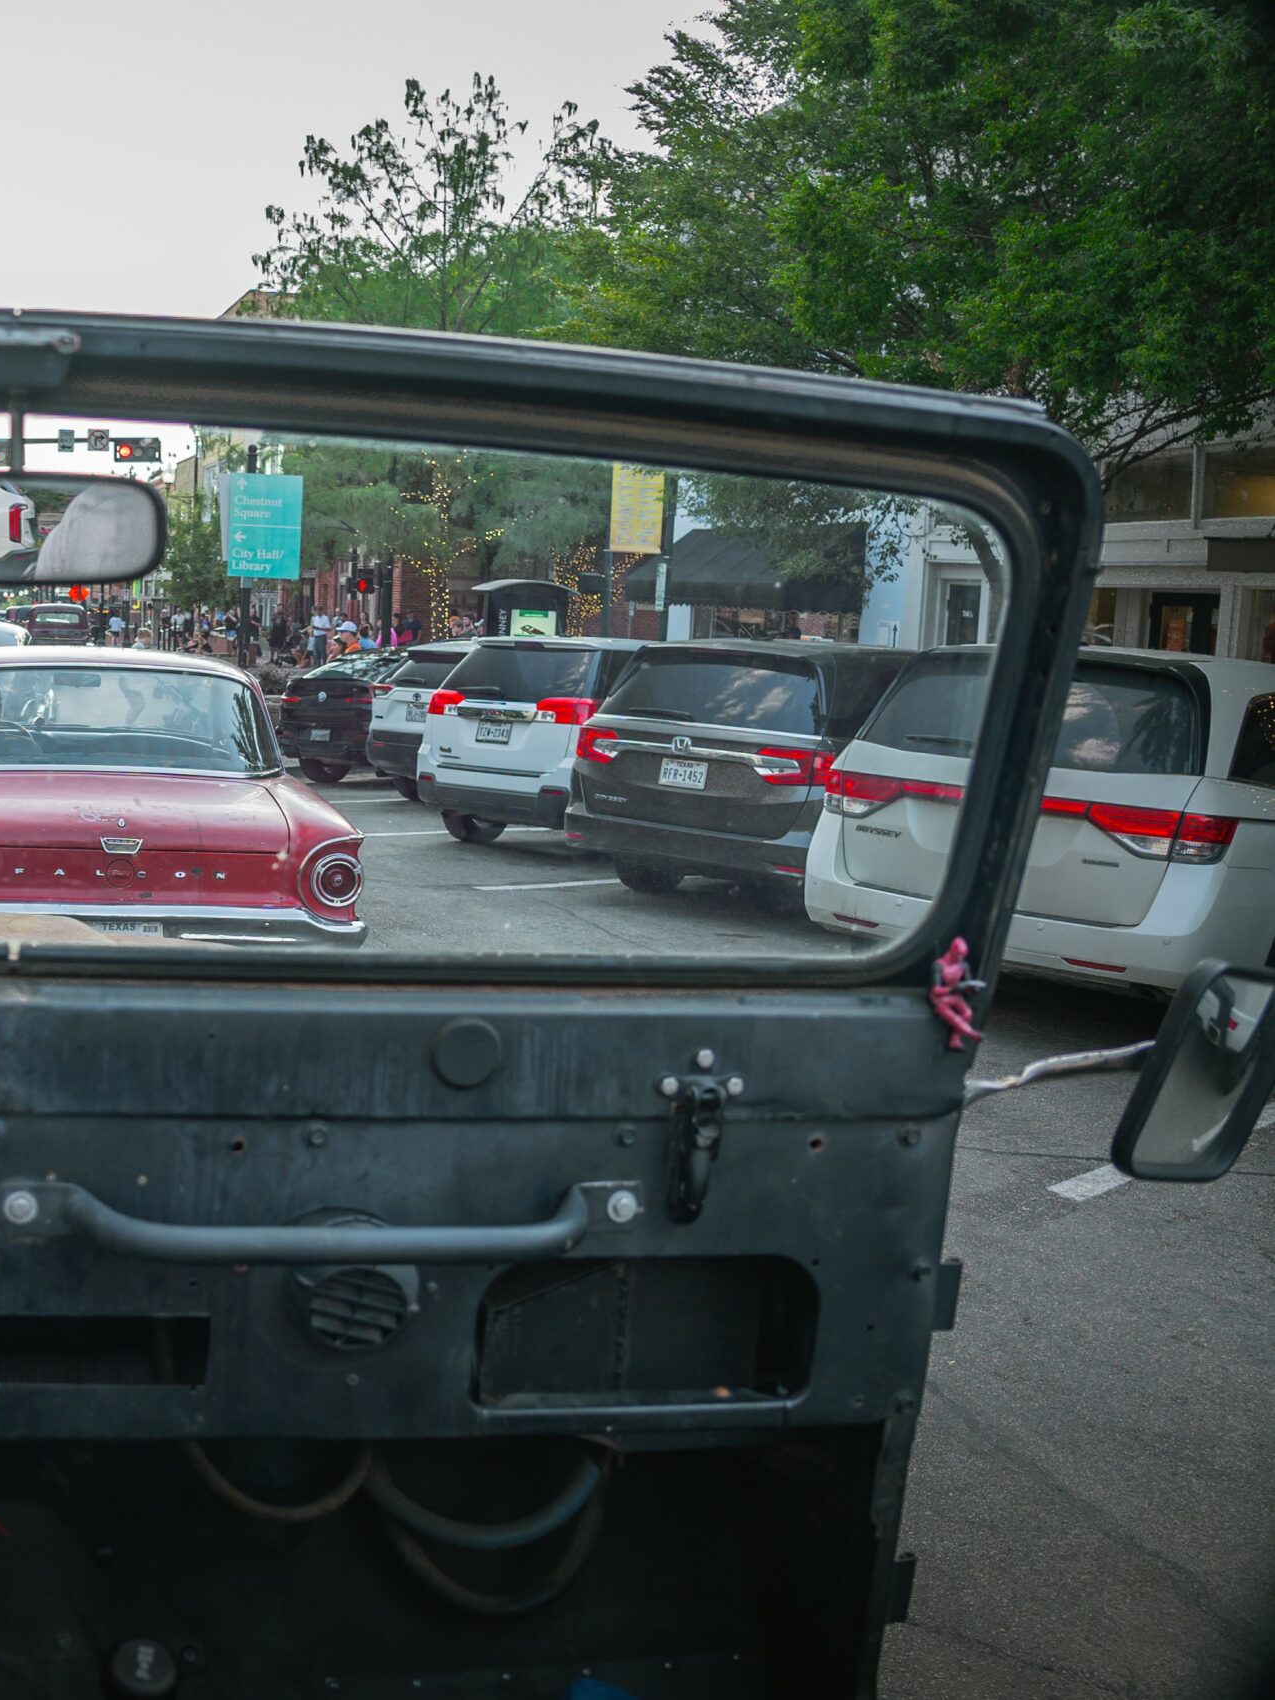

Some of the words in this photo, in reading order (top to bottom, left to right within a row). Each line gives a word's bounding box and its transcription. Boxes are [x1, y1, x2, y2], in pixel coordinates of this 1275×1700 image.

[233, 494, 283, 507] Chestnut
[233, 507, 271, 520] Square
[231, 547, 254, 560] City
[256, 548, 284, 560] Hall/
[231, 560, 272, 574] Library
[855, 824, 902, 838] ODYSSEY
[14, 867, 227, 880] FALCON
[101, 922, 136, 931] TEXAS
